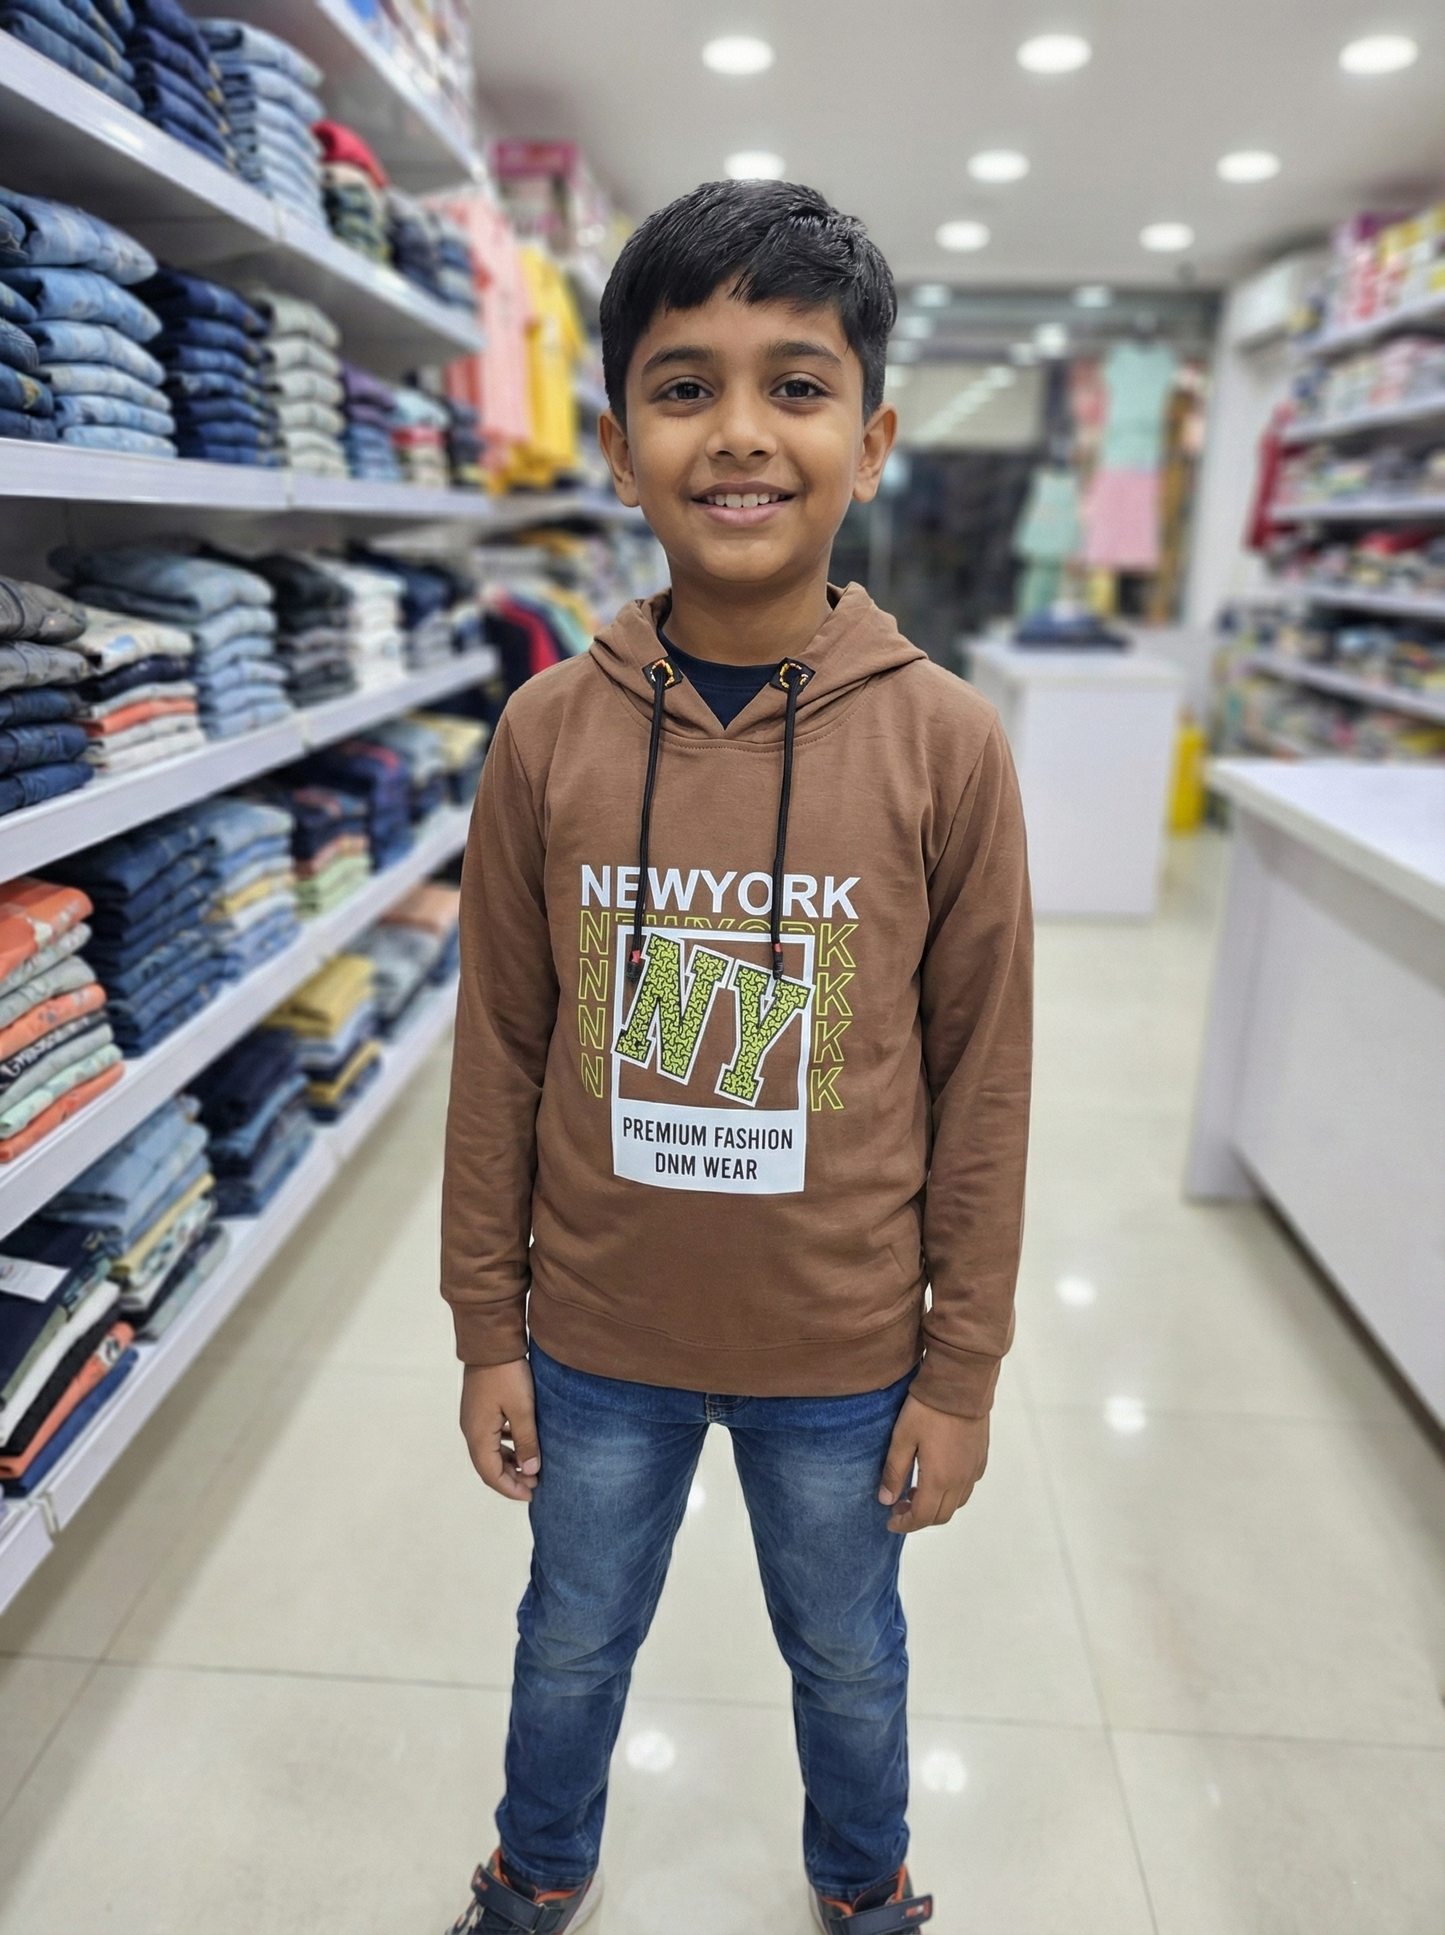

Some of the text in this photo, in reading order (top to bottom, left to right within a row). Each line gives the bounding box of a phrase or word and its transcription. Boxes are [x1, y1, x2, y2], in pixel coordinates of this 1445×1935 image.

[581, 864, 861, 919] NEWYORK
[611, 932, 816, 1107] NY
[622, 1116, 793, 1150] PREMIUM FASHION
[655, 1152, 758, 1180] DNM WEAR
